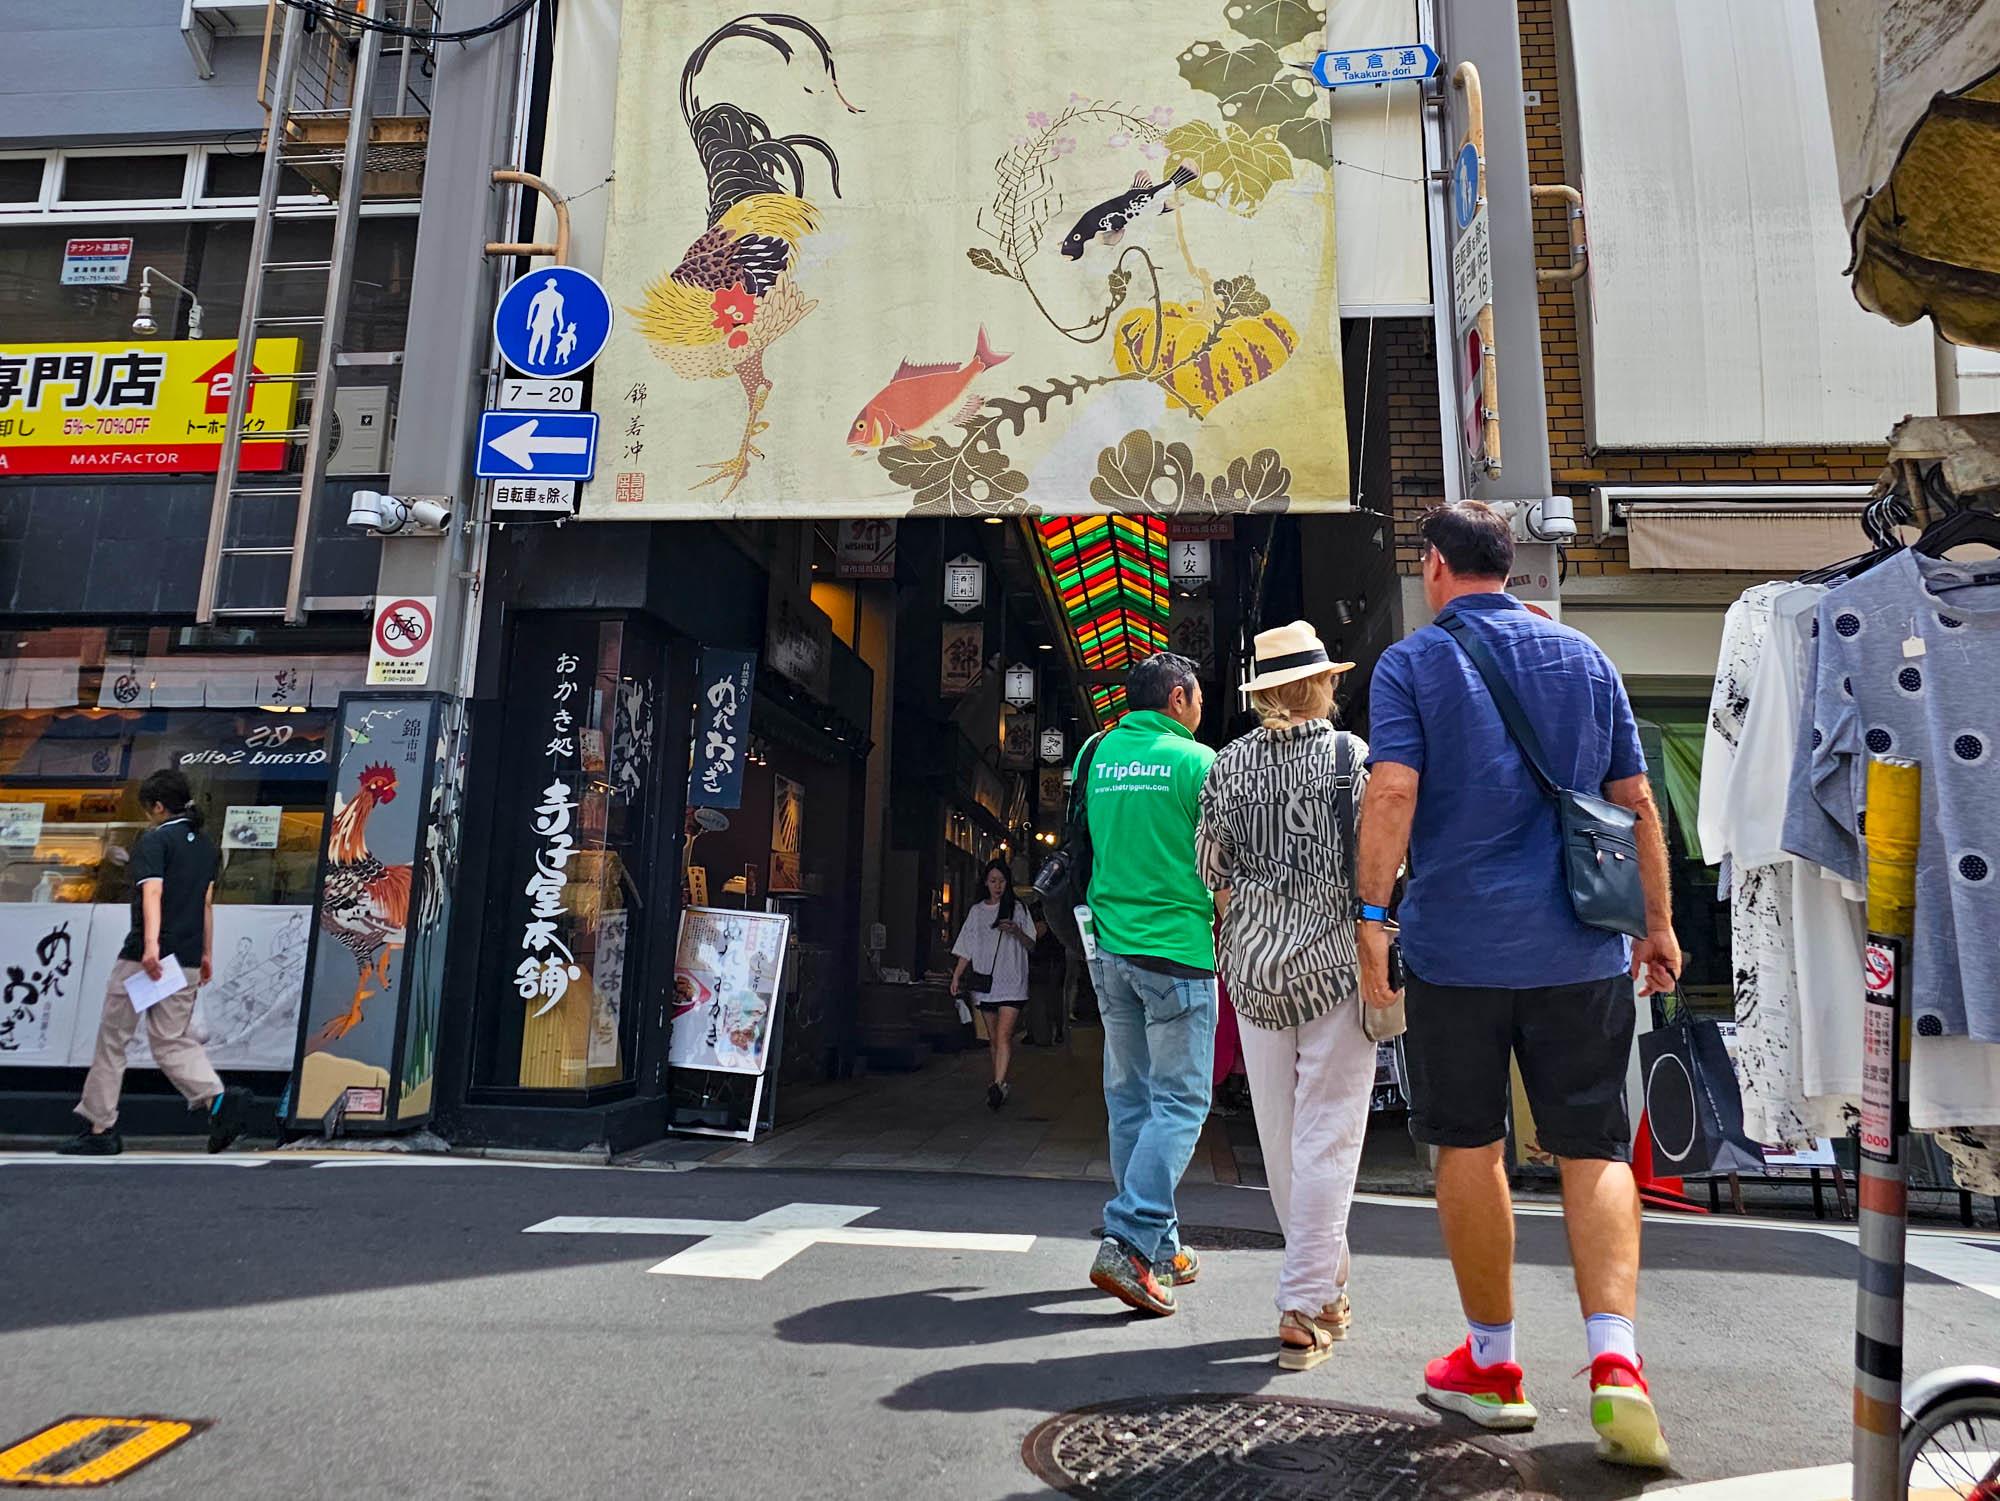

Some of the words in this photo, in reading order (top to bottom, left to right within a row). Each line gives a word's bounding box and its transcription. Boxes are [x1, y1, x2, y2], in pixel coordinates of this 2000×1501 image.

[1334, 50, 1417, 72] 高倉通
[496, 487, 569, 504] 自転車を除く
[1183, 543, 1196, 574] 大安
[545, 652, 579, 758] おかき処
[1095, 761, 1172, 781] TripGuru
[512, 777, 582, 1018] 寺子屋本舗
